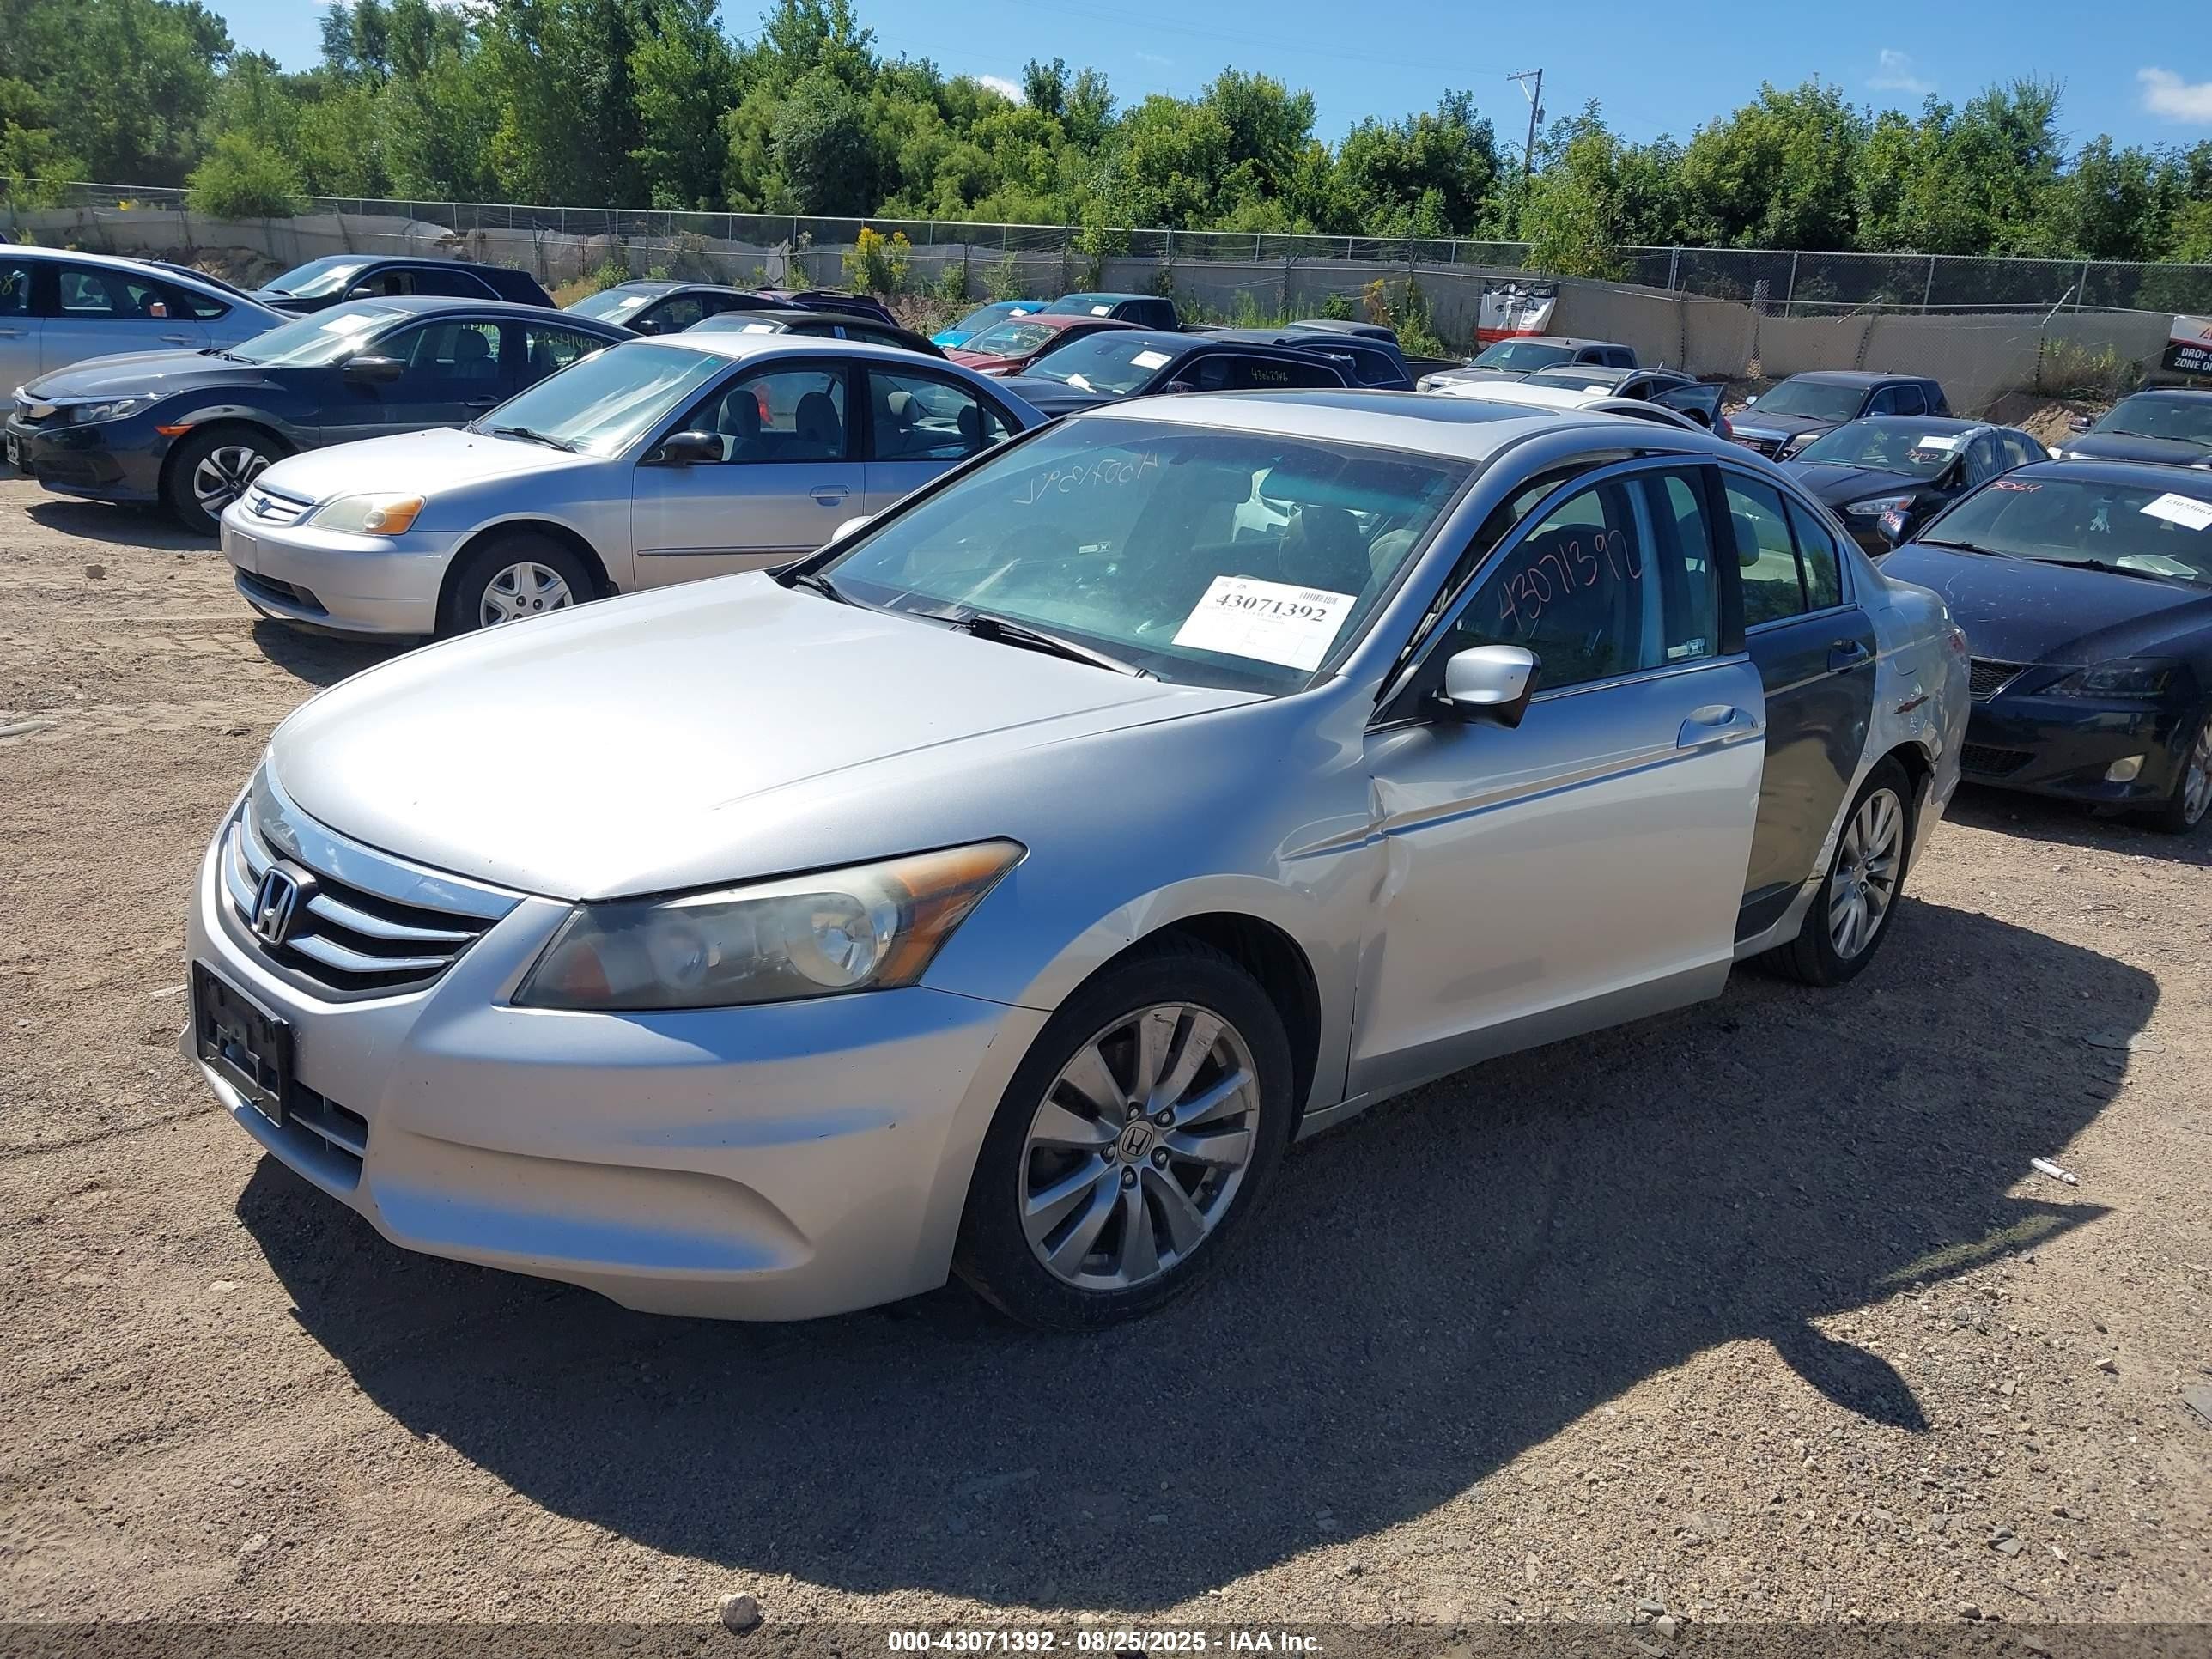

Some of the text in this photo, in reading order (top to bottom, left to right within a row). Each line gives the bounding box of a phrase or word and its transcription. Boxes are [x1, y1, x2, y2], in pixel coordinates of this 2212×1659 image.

[2174, 357, 2201, 369] ZONE
[1498, 530, 1642, 632] 43071392
[1216, 593, 1327, 622] 43071392
